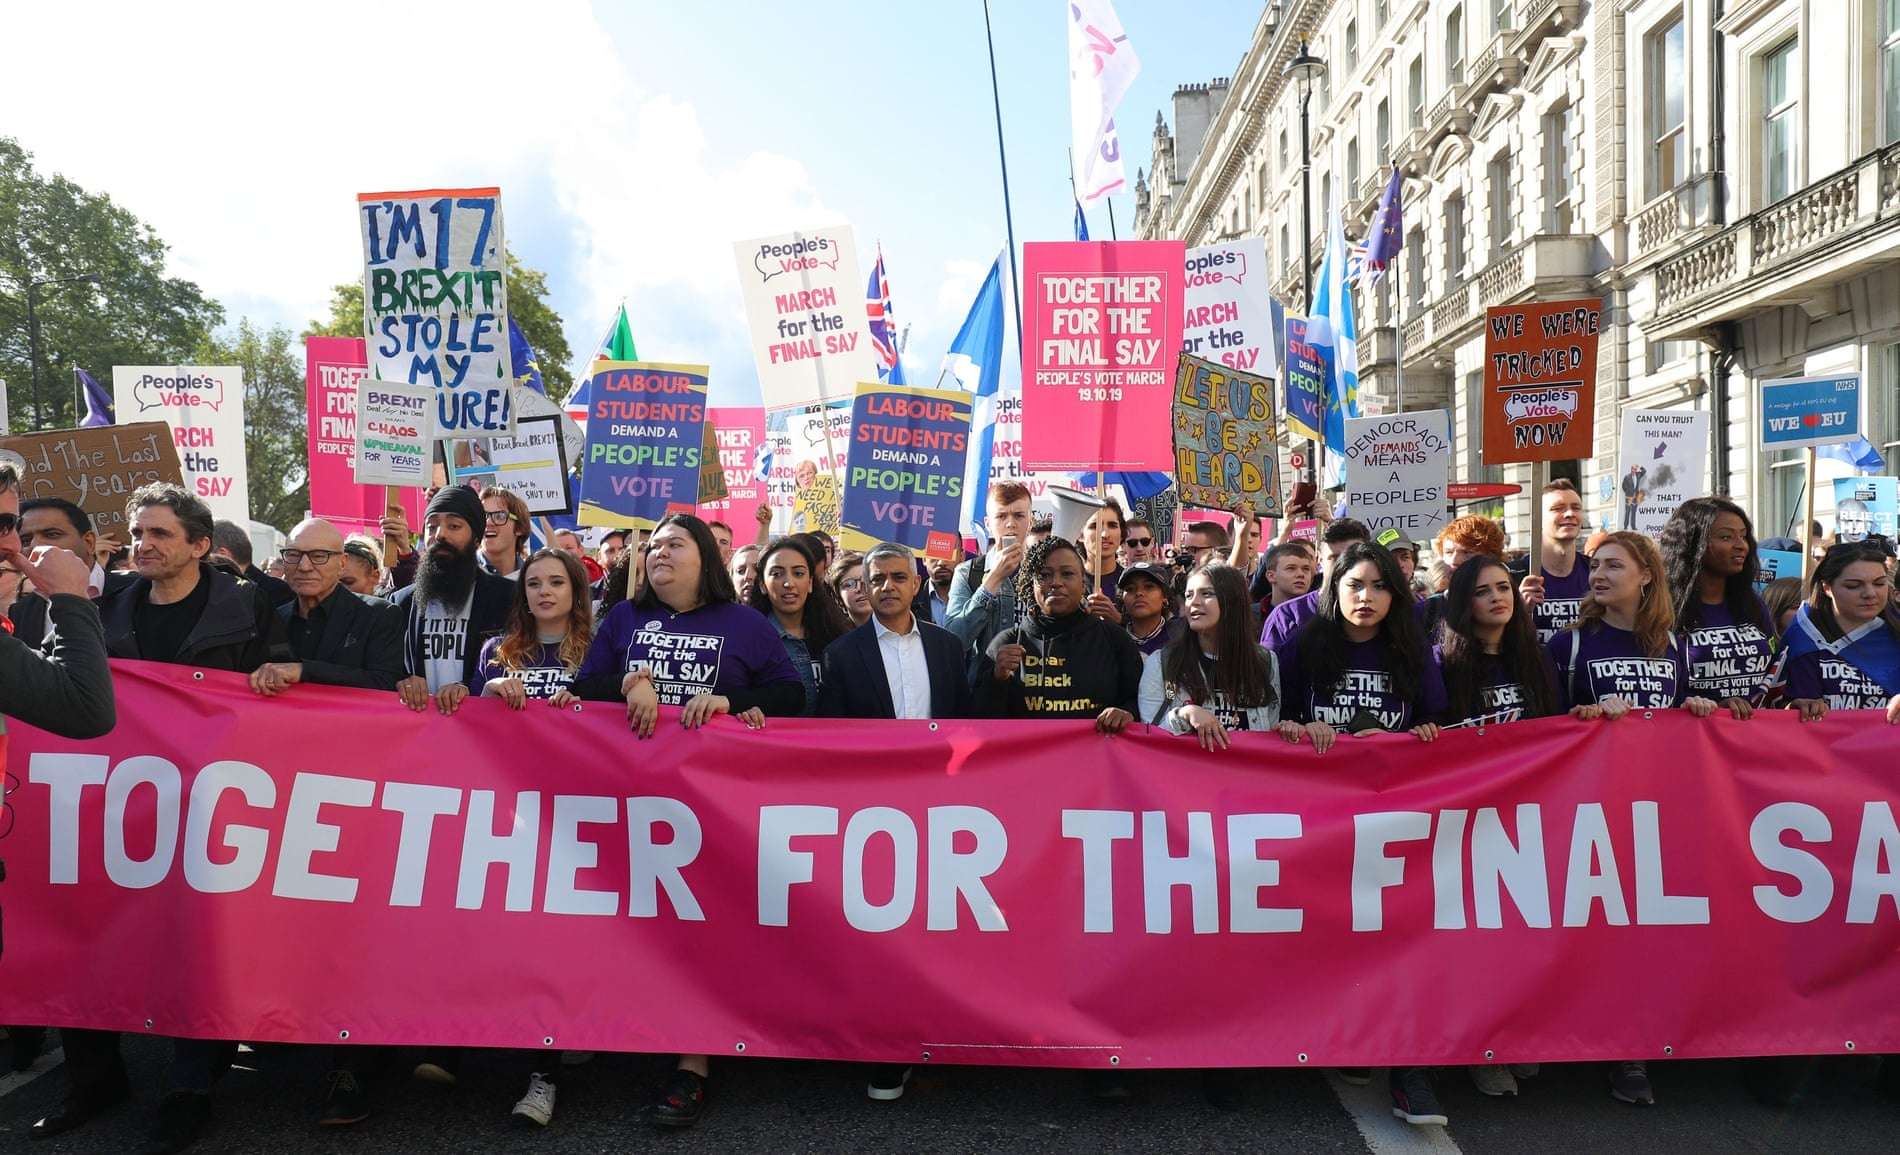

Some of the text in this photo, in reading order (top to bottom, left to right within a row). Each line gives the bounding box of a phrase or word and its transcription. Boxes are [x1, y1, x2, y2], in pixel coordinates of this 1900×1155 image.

[362, 201, 427, 265] I'M
[761, 236, 828, 259] People's
[780, 256, 818, 272] Vote
[1185, 250, 1236, 274] ople's
[372, 268, 501, 313] BREXIT
[1043, 276, 1161, 304] TOGETHER
[775, 287, 836, 314] MARCH
[1052, 308, 1151, 335] FOR THE
[1185, 301, 1239, 329] ARCH
[1491, 307, 1600, 341] WE WERE
[777, 312, 844, 338] for the
[379, 312, 495, 358] STOLE
[1183, 328, 1244, 354] or the
[769, 331, 858, 364] FINAL SAY
[1043, 339, 1161, 366] FINAL SAY
[1222, 347, 1260, 370] SAY
[1492, 346, 1582, 381] TRICKED
[408, 353, 471, 389] MY
[1036, 371, 1165, 385] PEOPLE'S VOTE MARCH
[142, 374, 214, 393] People's
[606, 373, 692, 395] LABOUR
[1180, 363, 1271, 422] LET US
[1837, 380, 1855, 391] NHS
[160, 391, 201, 406] Vote
[368, 391, 427, 409] BREXIT
[1078, 387, 1123, 401] 19.10.19
[1512, 388, 1570, 406] People's
[437, 389, 510, 431] URE!
[595, 400, 702, 423] STUDENTS
[867, 396, 954, 422] LABOUR
[995, 412, 1022, 424] ote
[1525, 405, 1558, 417] Vote
[321, 416, 356, 439] FINA
[368, 421, 418, 437] CHAOS
[1636, 415, 1694, 424] CAN YOU TRUST
[1768, 411, 1847, 432] WE EU
[174, 427, 214, 447] RCH
[611, 425, 678, 438] DEMAND A
[857, 423, 965, 451] STUDENTS
[1205, 411, 1239, 454] BE
[1345, 420, 1447, 459] DEMOCRACY
[1515, 422, 1568, 449] NOW
[1644, 430, 1683, 439] THIS MAN?
[364, 438, 425, 455] UPHEAVAL
[590, 443, 699, 468] PEOPLE'S
[1373, 441, 1420, 454] DEMANDS
[184, 452, 218, 472] the
[364, 451, 421, 466] FOR YEARS
[872, 449, 941, 466] DEMAND A
[1293, 455, 1302, 465] D
[1364, 451, 1426, 466] MEANS
[610, 475, 673, 498] VOTE
[724, 469, 754, 486] SAY
[851, 466, 961, 497] PEOPLE'S
[1389, 471, 1400, 483] A
[197, 477, 233, 497] SAY
[731, 489, 757, 499] MARCH
[796, 490, 825, 501] NEED
[1022, 480, 1047, 497] AY
[1351, 487, 1441, 505] PEOPLES'
[1657, 494, 1681, 502] THAT'S
[871, 501, 936, 526] VOTE
[1639, 507, 1656, 515] WHY
[1840, 511, 1893, 521] REJECT
[1367, 515, 1419, 530] VOTE
[424, 634, 464, 660] EOPL
[636, 631, 718, 650] TOGETHER
[648, 647, 696, 660] for the
[1712, 643, 1758, 658] for the
[1025, 655, 1065, 666] Dear
[1592, 660, 1674, 679] TOGETHER
[1693, 658, 1740, 677] FINAL
[679, 662, 715, 681] SAY
[1025, 673, 1072, 687] Black
[662, 683, 684, 694] VOTE
[685, 685, 713, 695] MARCH
[1615, 677, 1662, 691] for the
[1689, 679, 1729, 689] PEOPLE'S
[1731, 677, 1751, 687] VOTE
[1720, 687, 1749, 697] 19.10.19
[1839, 680, 1860, 693] for
[1358, 692, 1382, 707] the
[29, 752, 1900, 934] TOGETHER FOR THE FINAL SA
